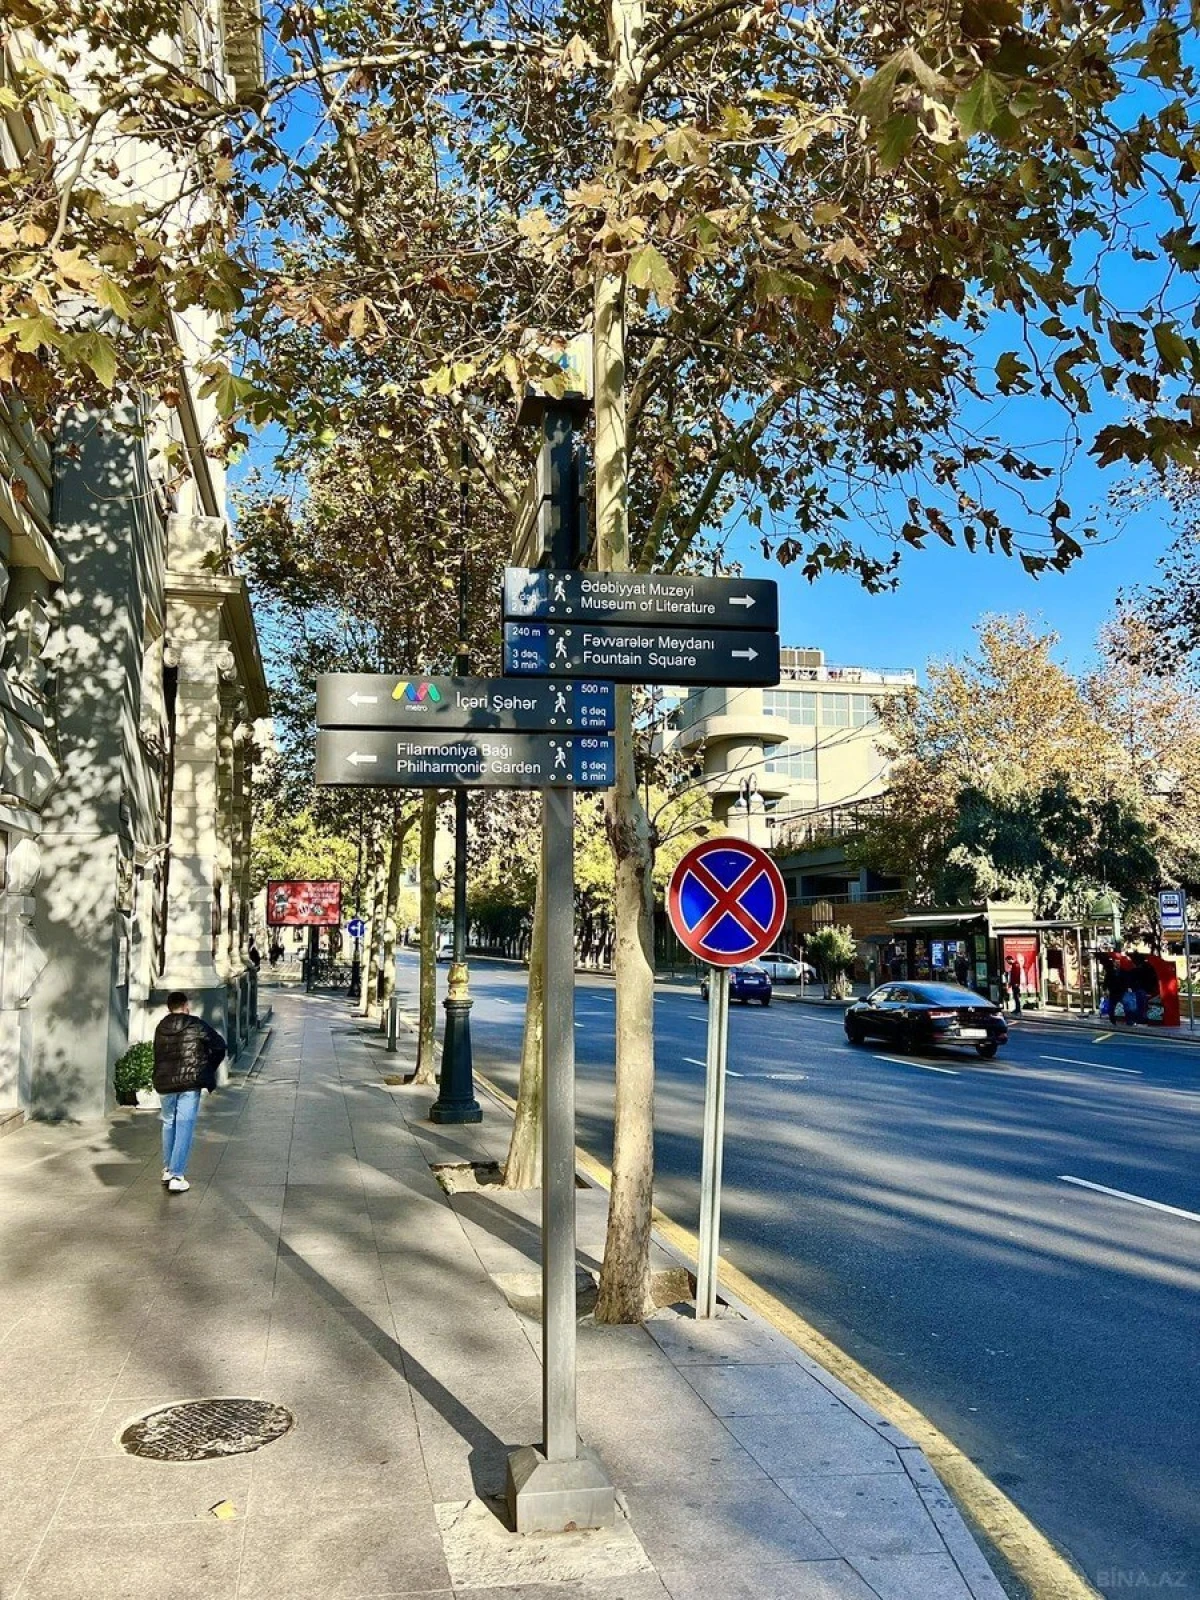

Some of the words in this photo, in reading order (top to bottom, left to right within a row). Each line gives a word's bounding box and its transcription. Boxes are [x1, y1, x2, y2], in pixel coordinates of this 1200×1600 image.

[580, 579, 646, 597] Ədəbiyyat
[650, 583, 694, 600] Muzeyi
[580, 596, 637, 609] Museum
[639, 599, 653, 612] of
[656, 600, 716, 614] Literature
[512, 626, 530, 636] 240
[531, 628, 541, 637] m
[583, 633, 654, 649] Fəvvarələr
[658, 635, 715, 652] Meydanı
[512, 648, 519, 658] 3
[512, 659, 519, 669] 3
[520, 659, 538, 669] min
[583, 651, 642, 665] Fountain
[648, 652, 697, 668] Square
[580, 683, 598, 694] 500
[599, 686, 609, 694] m
[404, 703, 428, 712] metro
[492, 694, 537, 713] Şəhər
[580, 706, 588, 716] 6
[580, 716, 588, 726] 6
[589, 717, 606, 727] min
[580, 738, 598, 749] 650
[599, 740, 609, 749] m
[396, 742, 477, 760] Filarmoniya
[481, 743, 512, 760] Bağı
[396, 759, 488, 773] Philharmonic
[491, 760, 541, 774] Garden
[580, 760, 588, 770] 8
[580, 771, 588, 781] 8
[589, 771, 606, 781] min
